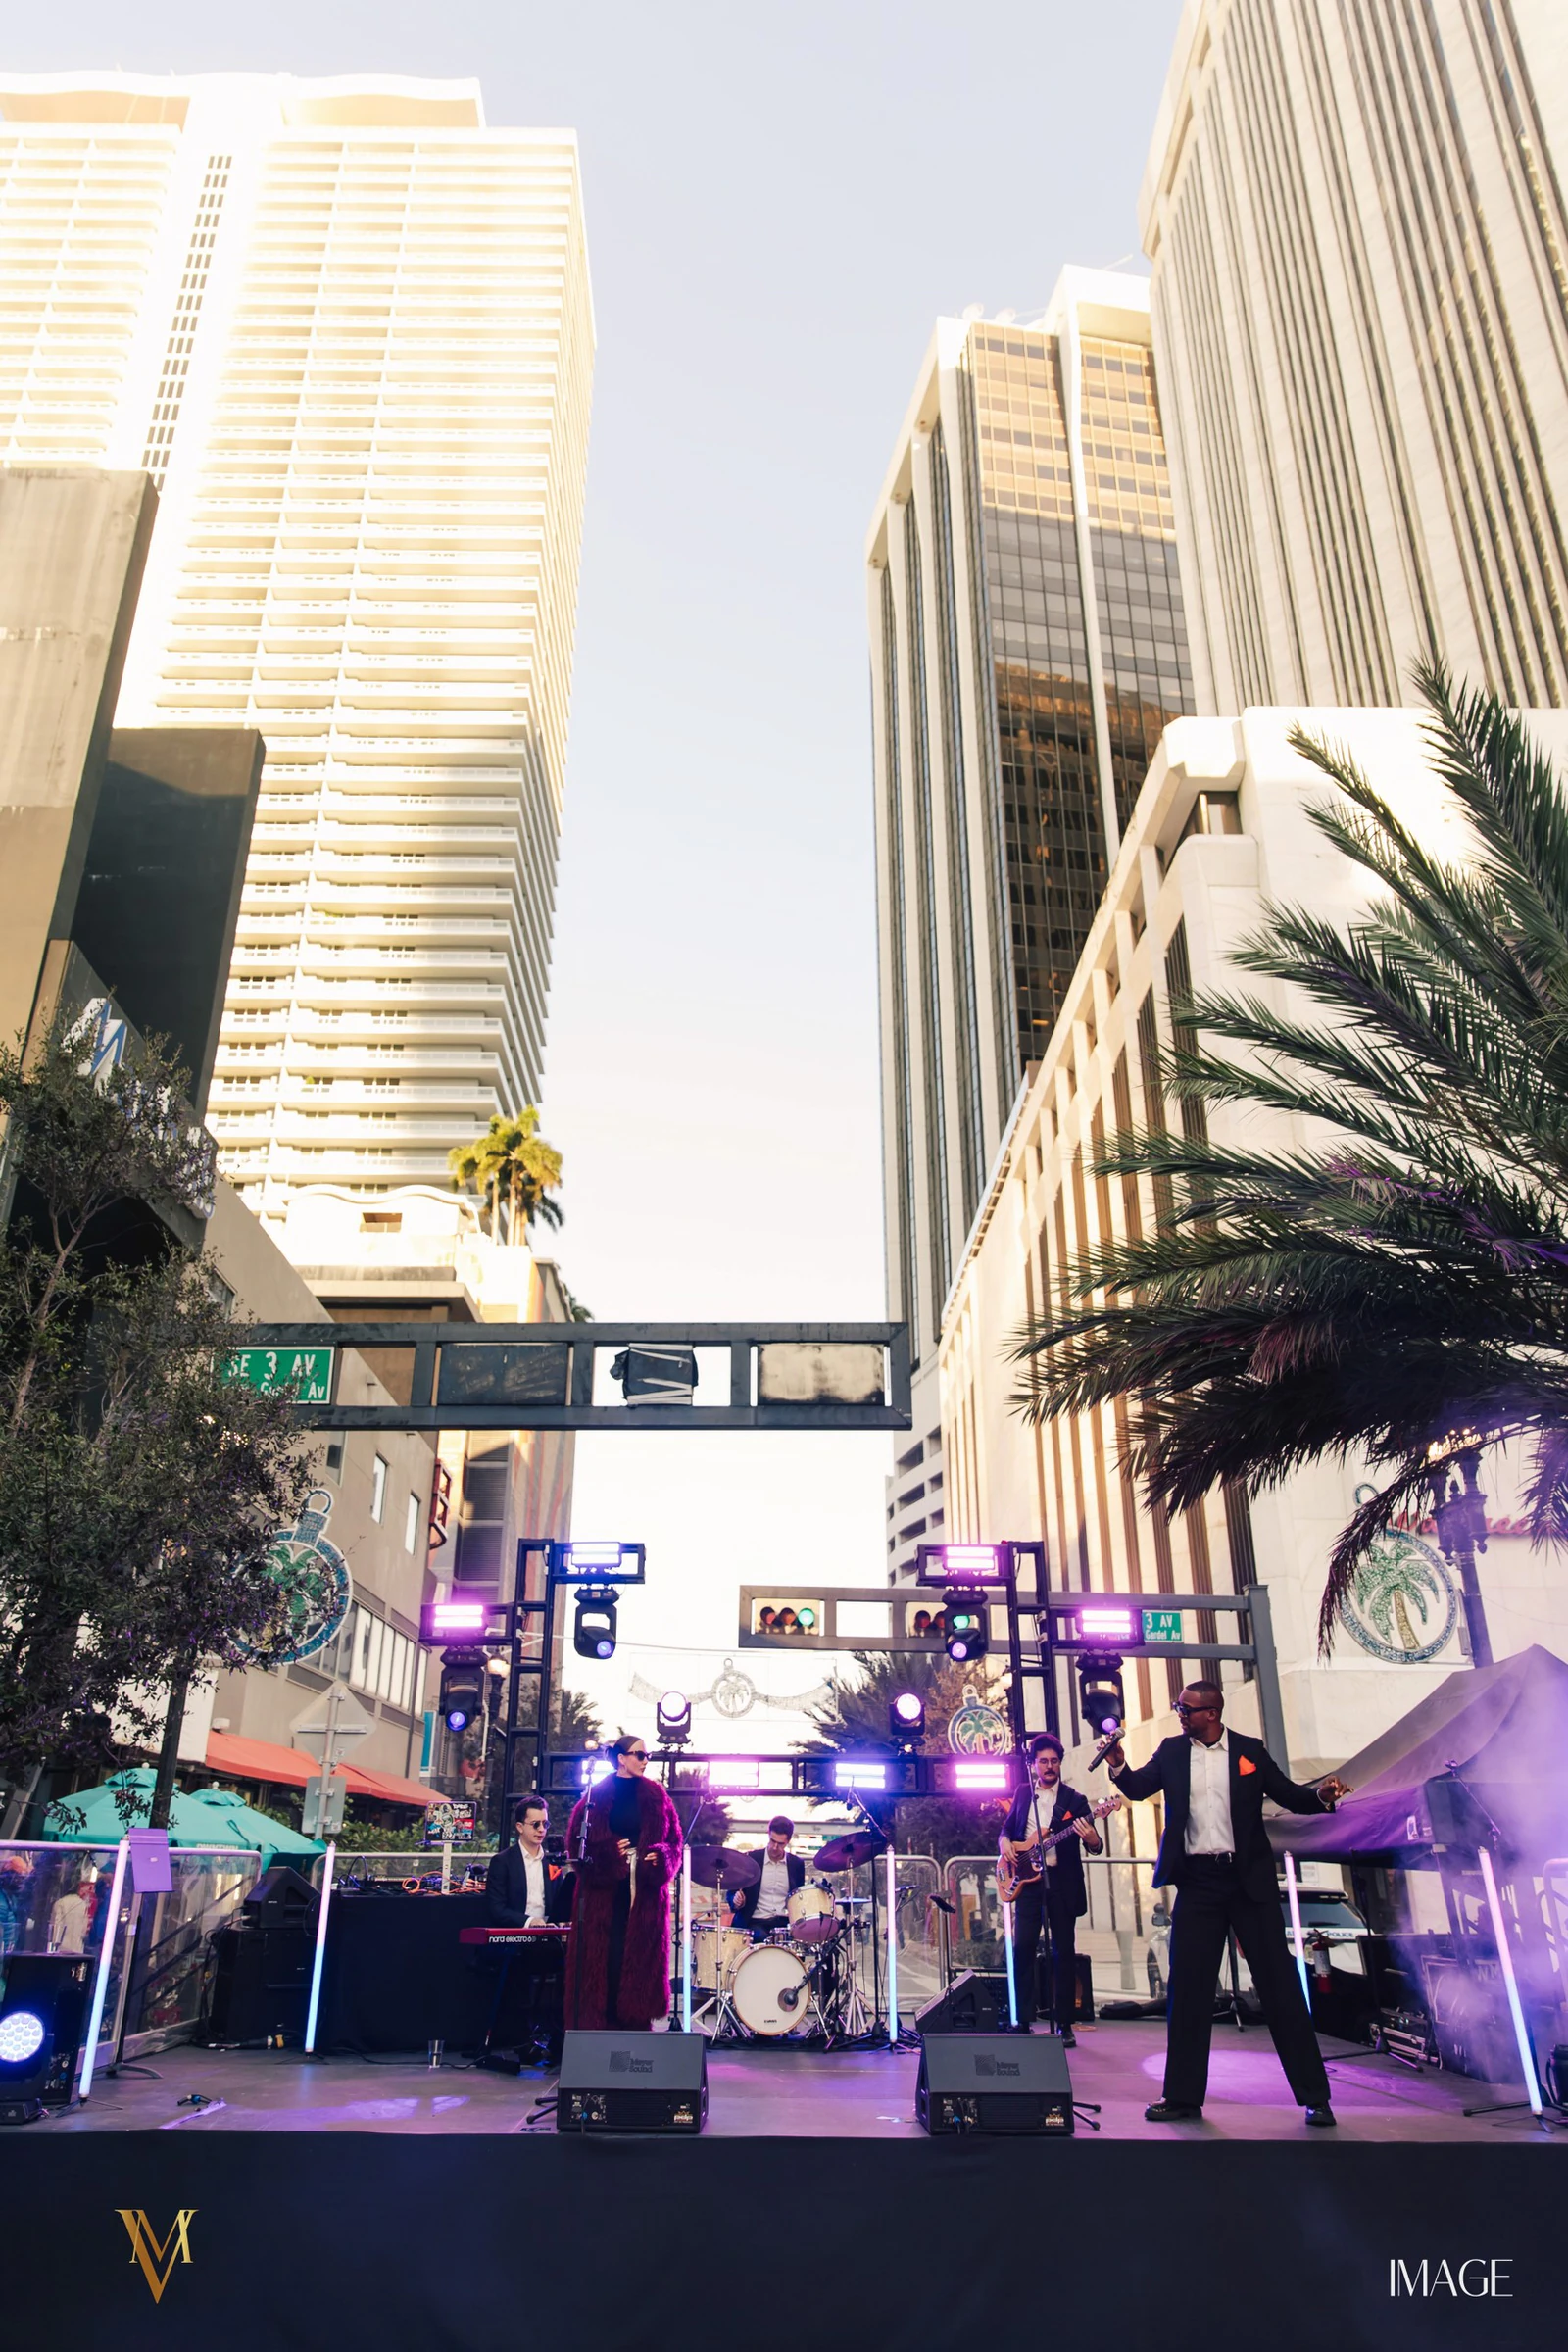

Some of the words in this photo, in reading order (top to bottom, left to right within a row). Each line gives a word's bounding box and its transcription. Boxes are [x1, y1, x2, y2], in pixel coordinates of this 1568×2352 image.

[228, 1354, 251, 1378] SE
[263, 1351, 277, 1381] 3
[291, 1354, 316, 1377] AV
[307, 1382, 325, 1399] Av
[1146, 1612, 1153, 1630] 3
[1159, 1614, 1173, 1628] AV
[1171, 1630, 1181, 1640] Av
[488, 1935, 505, 1943] nord
[506, 1935, 527, 1943] electro
